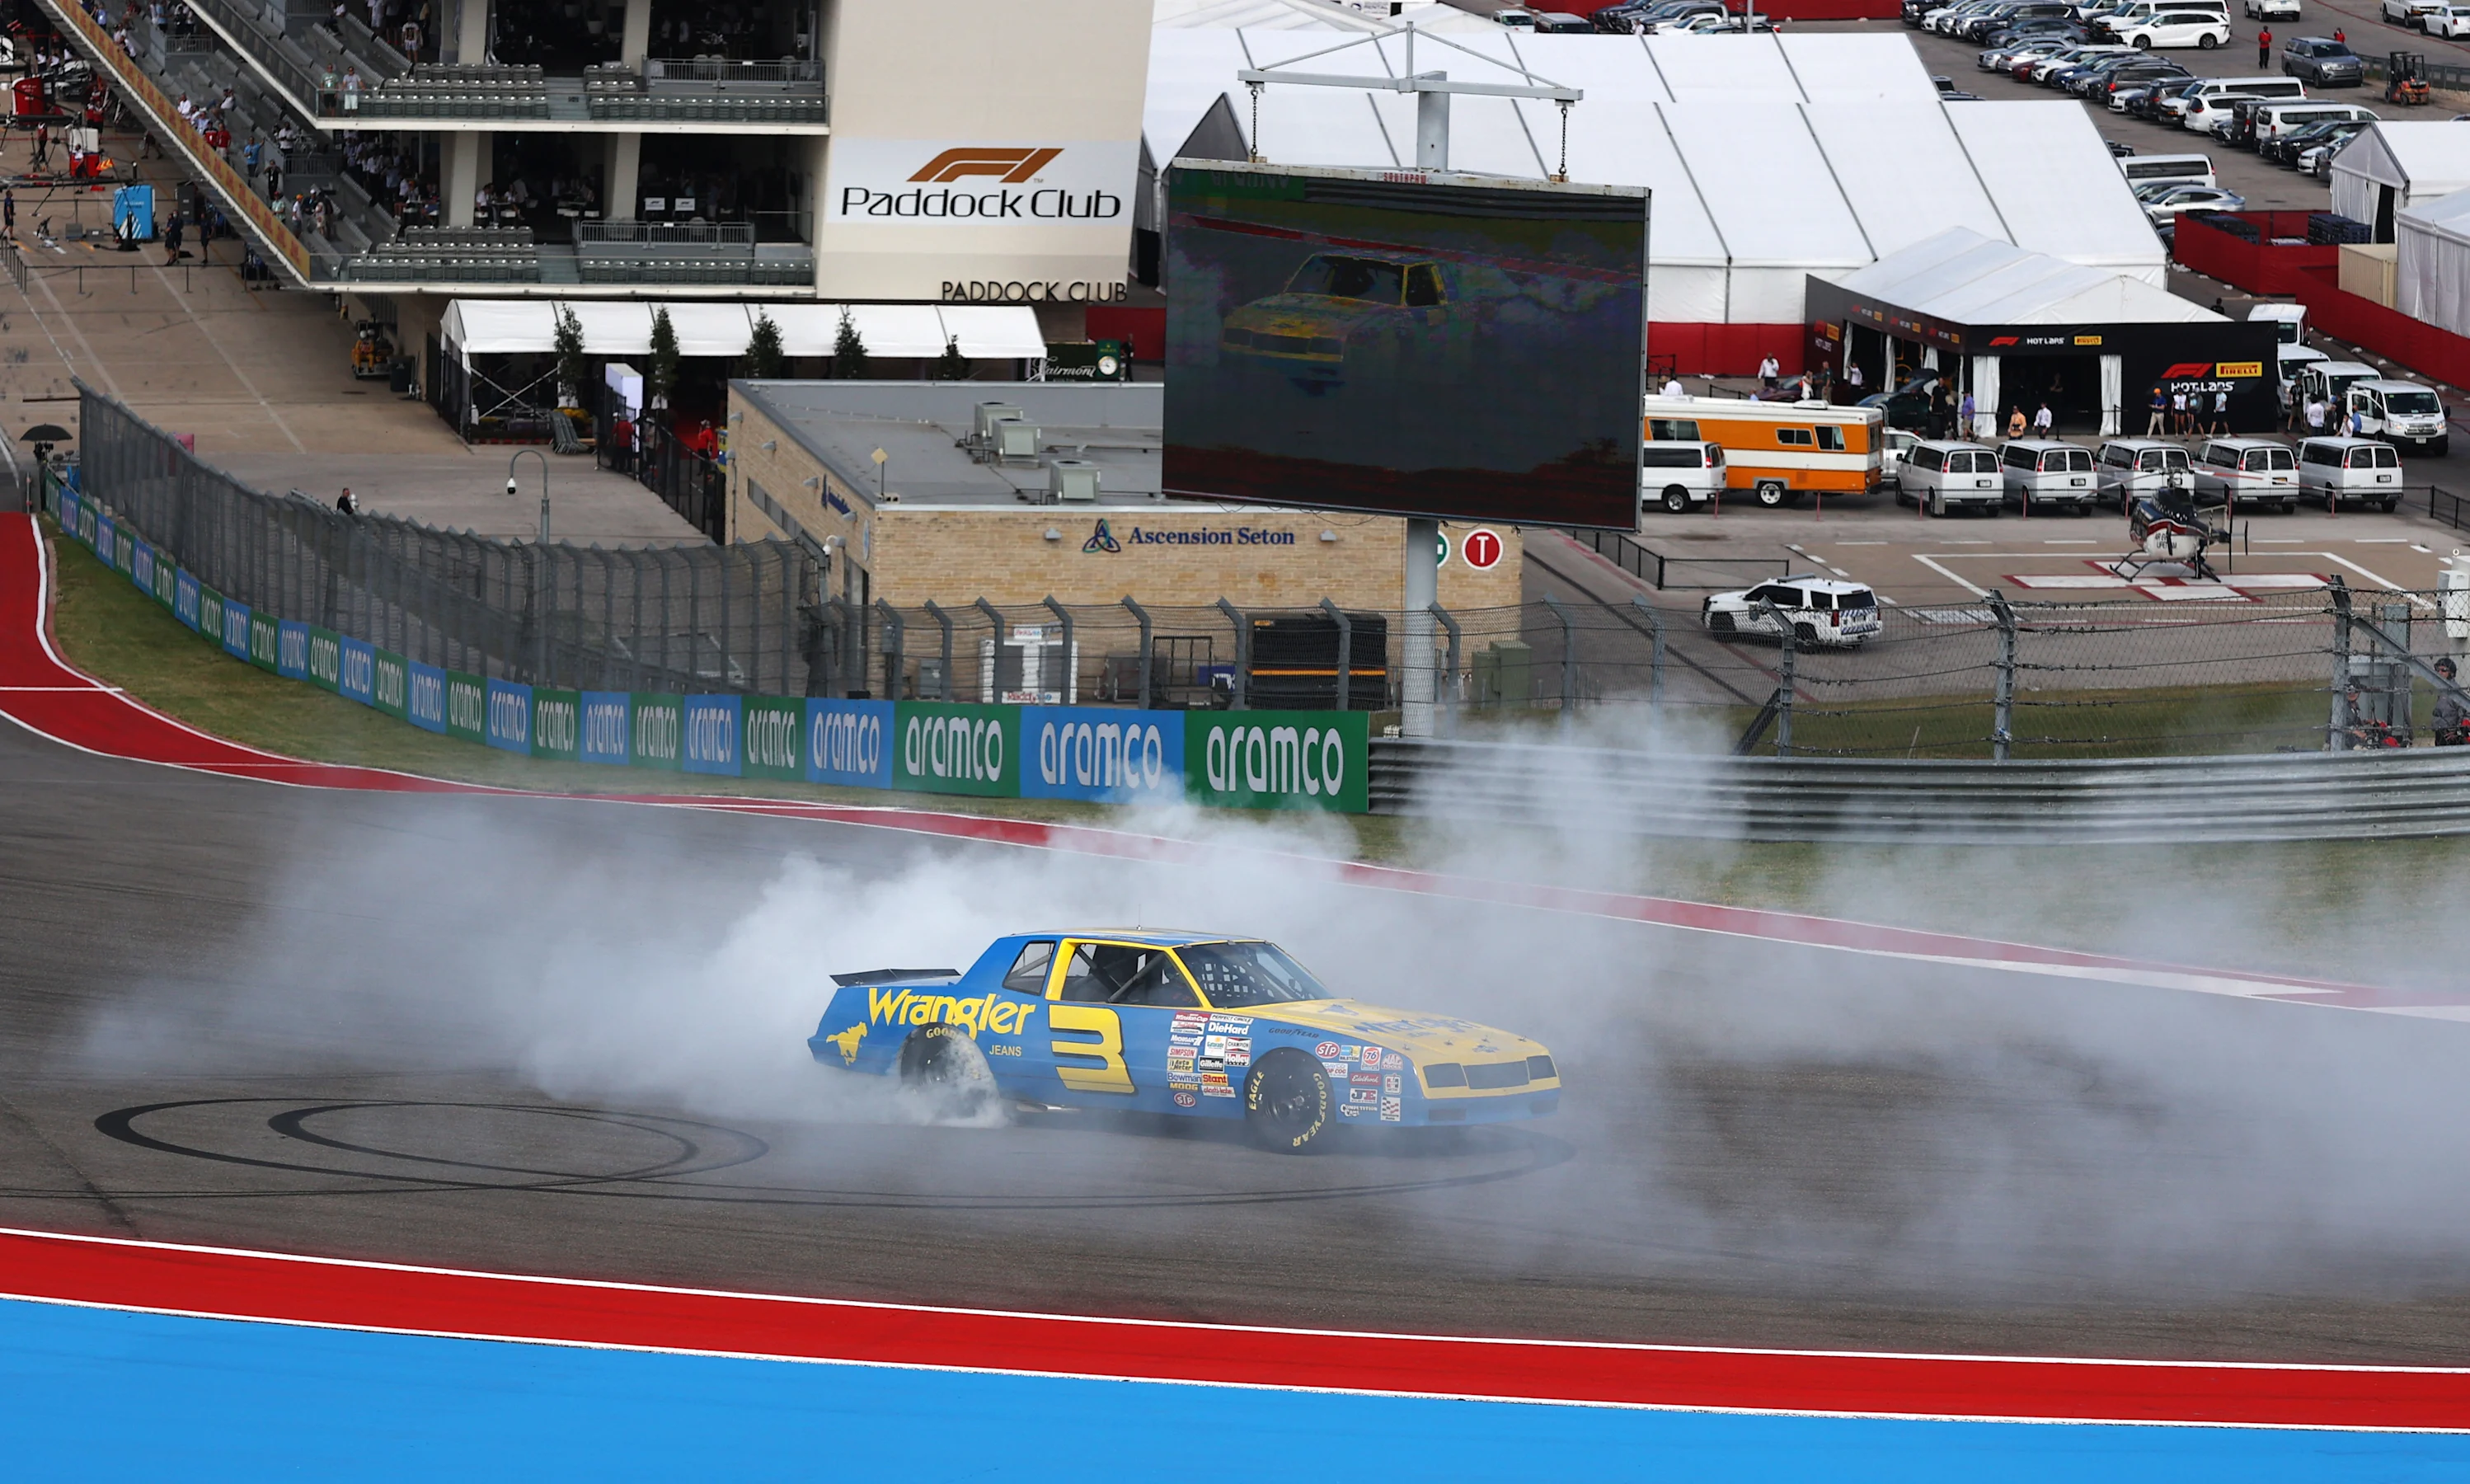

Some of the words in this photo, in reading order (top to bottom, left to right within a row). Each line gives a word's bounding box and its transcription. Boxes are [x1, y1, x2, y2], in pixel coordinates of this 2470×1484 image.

[842, 187, 1023, 218] Paddock
[1031, 190, 1121, 218] Club
[942, 281, 1059, 302] PADDOCK
[1068, 281, 1127, 302] CLUB
[2171, 382, 2199, 392] HOT
[1128, 528, 1233, 544] Ascension
[1237, 528, 1295, 545] Seton
[1476, 536, 1490, 563] T
[310, 636, 338, 683] aramco
[450, 681, 481, 732] aramco
[491, 691, 526, 742] aramco
[537, 699, 574, 751] aramco
[586, 704, 625, 756] aramco
[636, 705, 677, 760] aramco
[688, 707, 732, 763] aramco
[748, 710, 796, 769] aramco
[813, 711, 879, 774] aramco
[905, 715, 1003, 782] aramco
[1040, 721, 1162, 789] aramco
[1207, 725, 1344, 796] aramco
[869, 988, 1036, 1040] Wrangler
[1208, 1021, 1249, 1035] DieHard
[989, 1045, 1021, 1057] JEANS
[1049, 1004, 1135, 1094] 3
[1170, 1048, 1195, 1057] SIMPSON
[1226, 1054, 1249, 1065] Holley
[1318, 1043, 1337, 1056] STP
[1365, 1050, 1377, 1059] 76
[1167, 1072, 1201, 1082] Bowman
[1169, 1082, 1198, 1091] MOOG
[1203, 1074, 1226, 1082] Stant
[1249, 1071, 1264, 1110] EAGLE
[1352, 1074, 1378, 1082] Edelbrock
[1176, 1094, 1193, 1104] STP
[1293, 1073, 1327, 1147] GOODYEAR
[1351, 1089, 1376, 1100] JE
